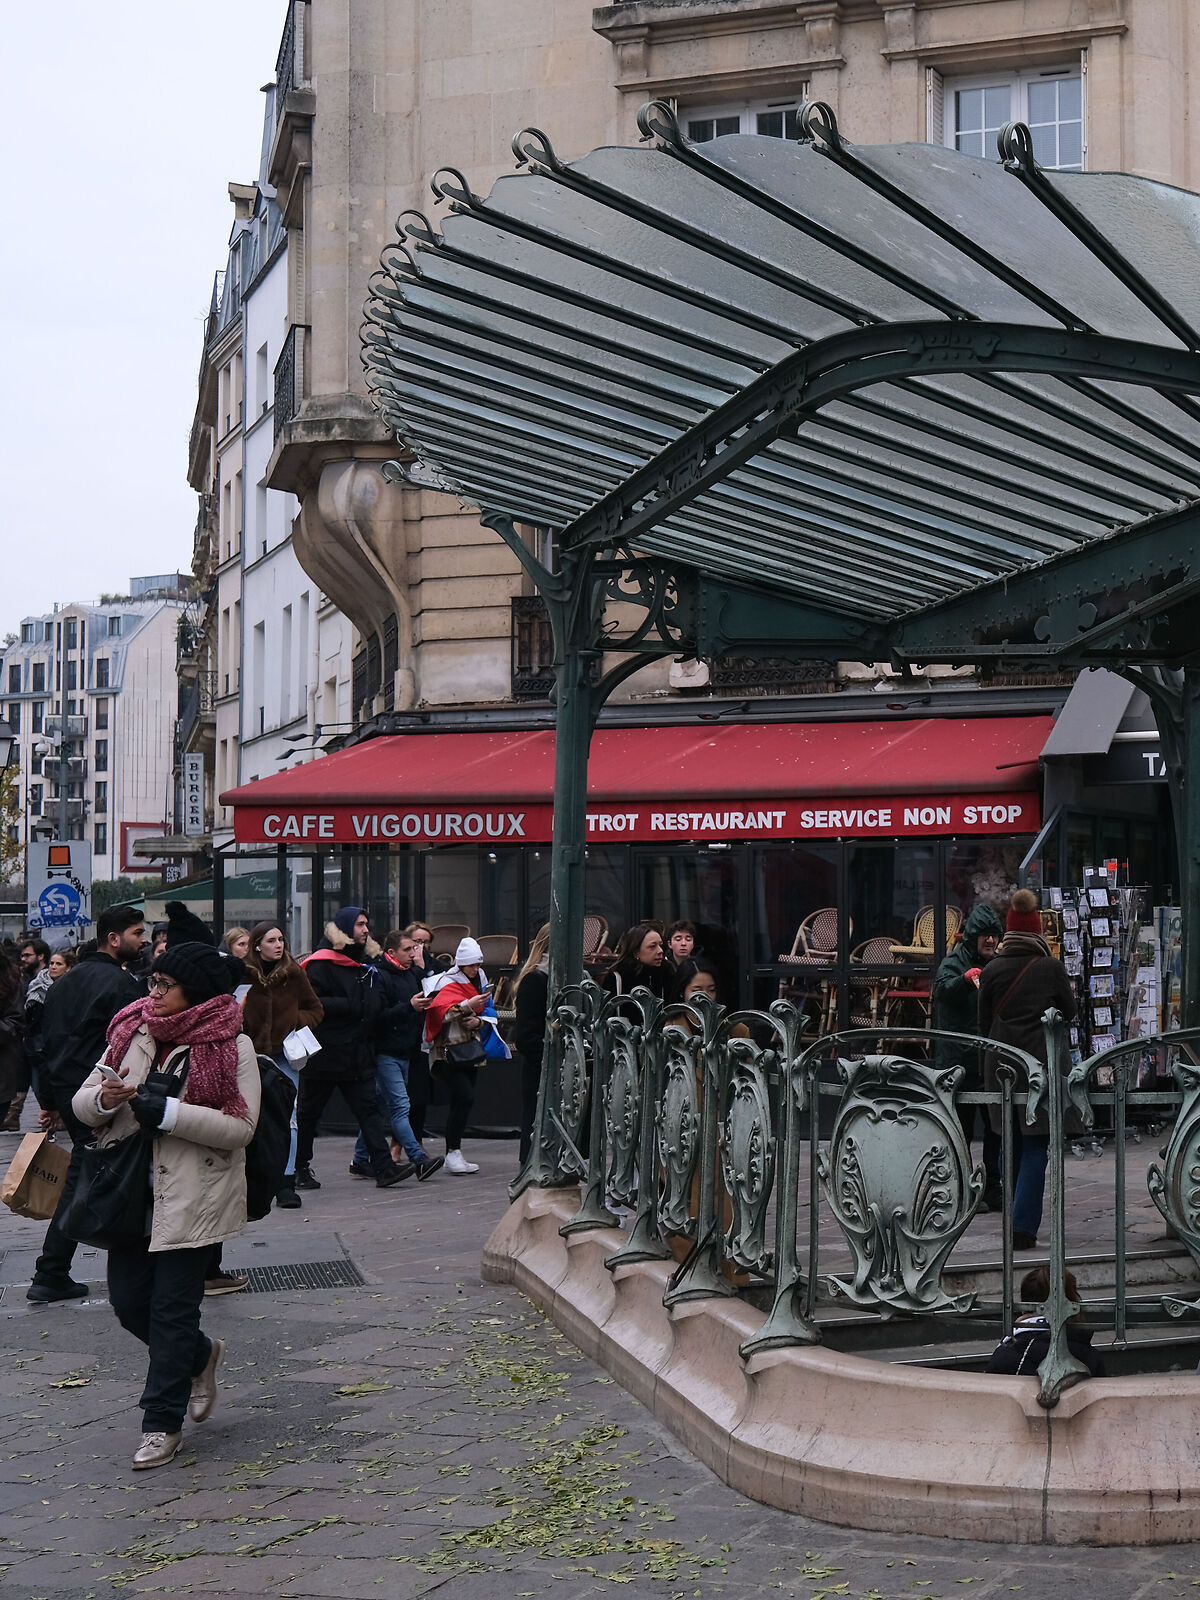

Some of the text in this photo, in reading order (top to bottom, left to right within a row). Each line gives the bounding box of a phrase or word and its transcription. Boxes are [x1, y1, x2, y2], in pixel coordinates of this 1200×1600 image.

[189, 762, 200, 825] BURGER
[263, 814, 335, 838] CAFE
[352, 813, 526, 838] VIGOUROUX
[651, 811, 786, 831] RESTAURANT
[800, 808, 891, 829] SERVICE
[904, 806, 952, 826] NON
[963, 805, 1022, 824] STOP
